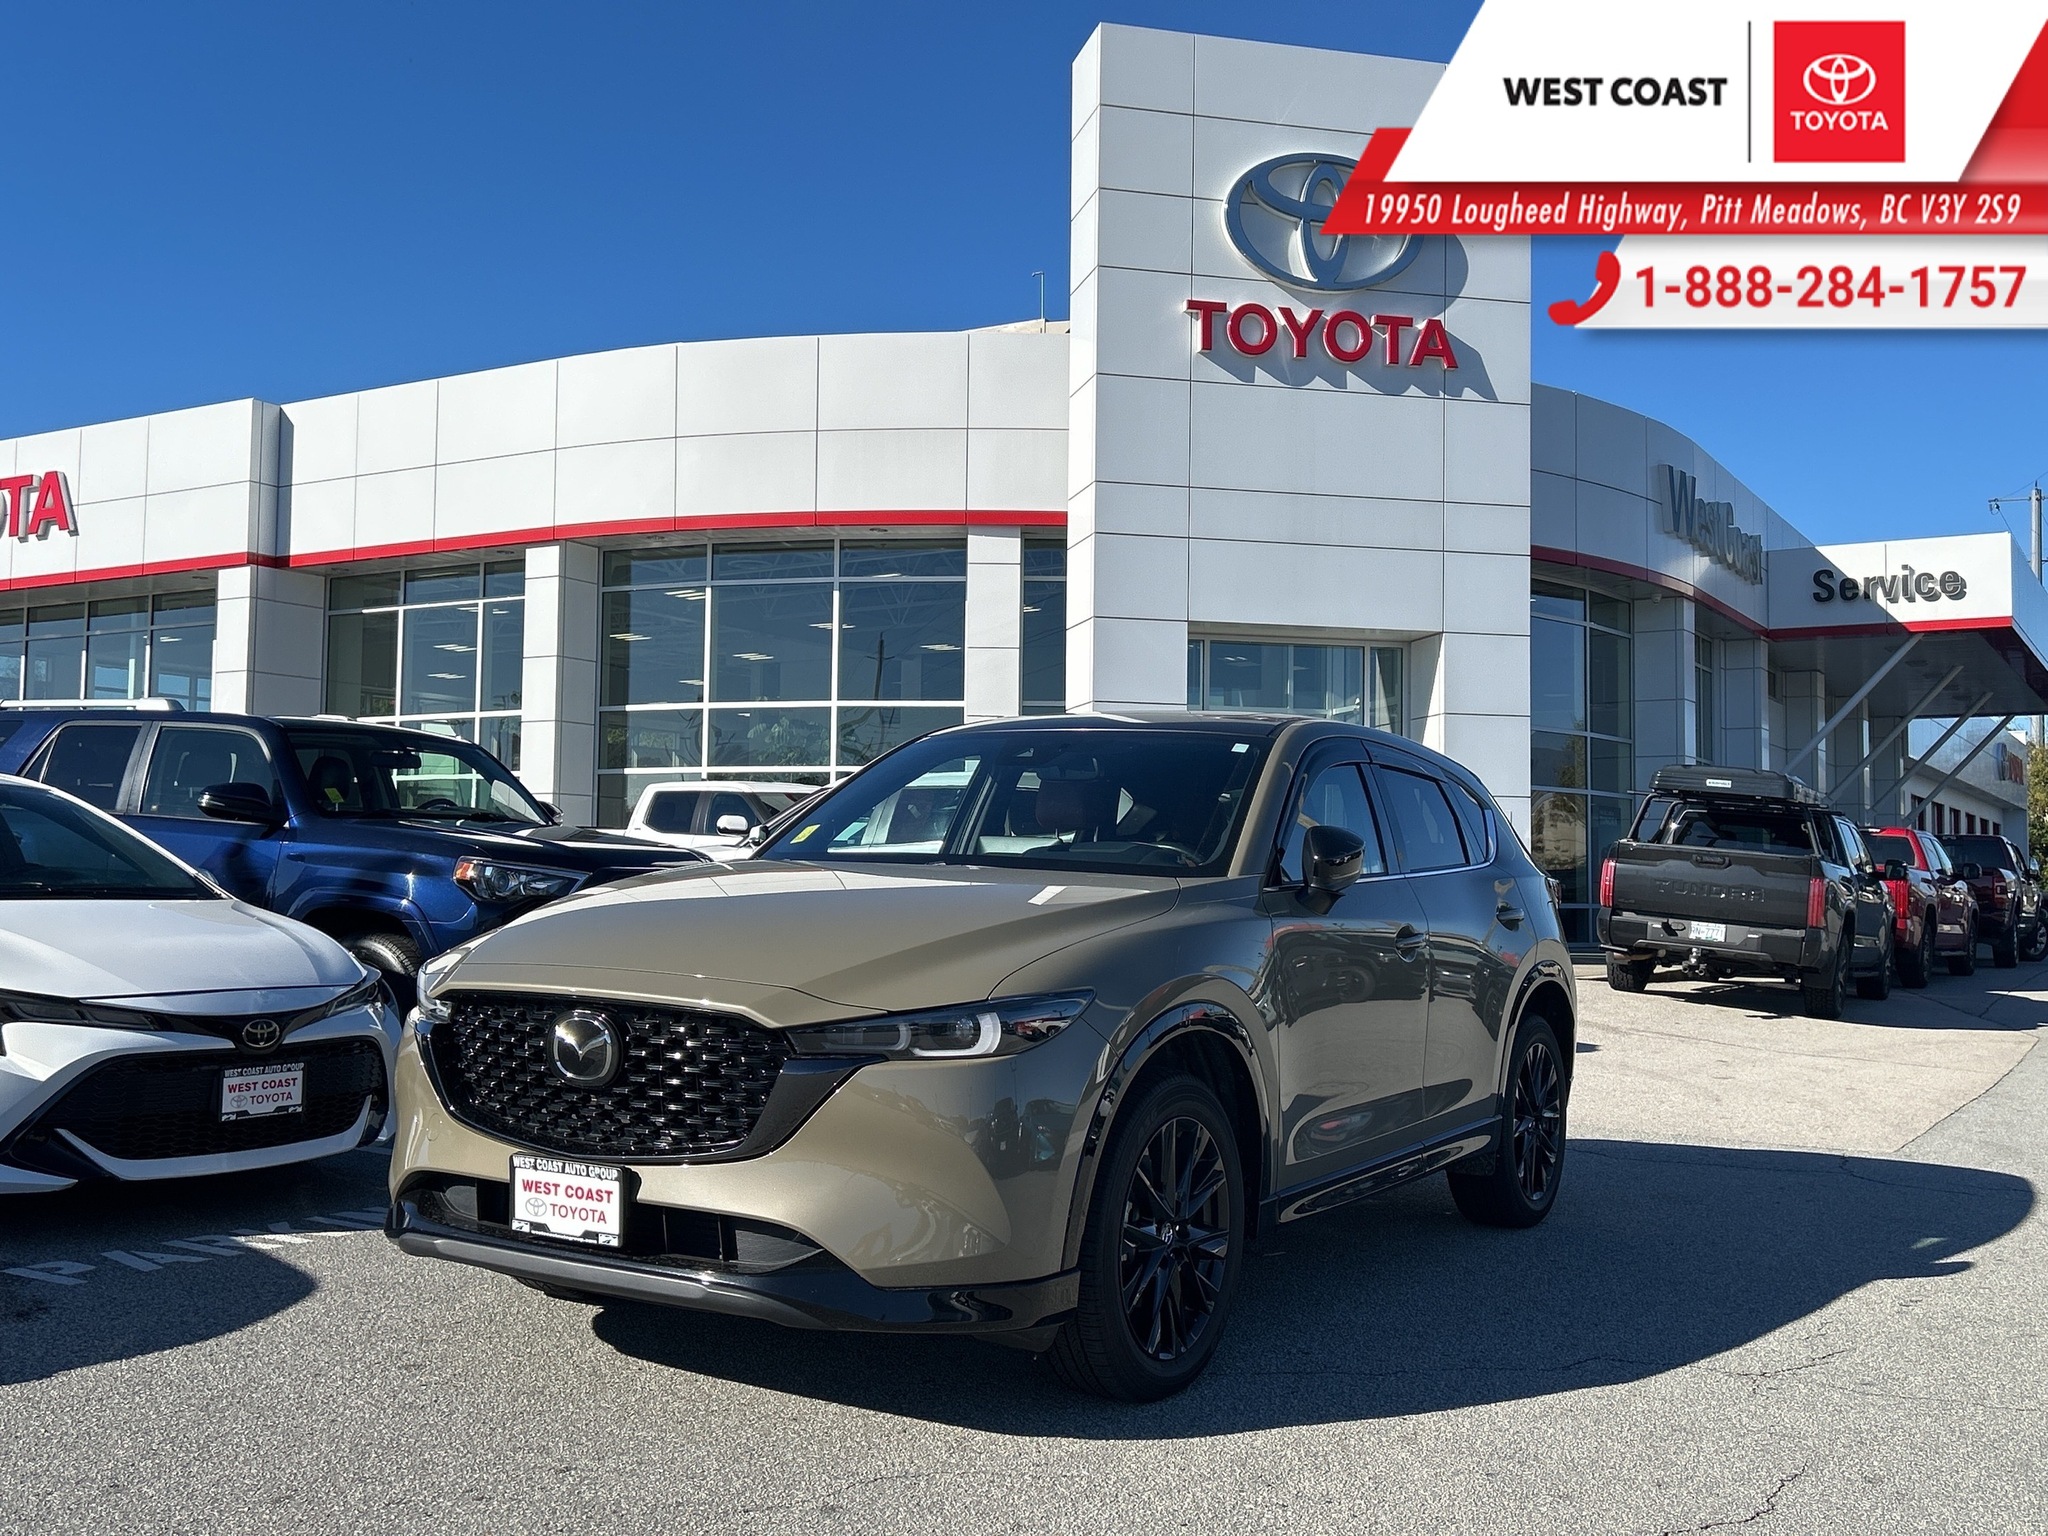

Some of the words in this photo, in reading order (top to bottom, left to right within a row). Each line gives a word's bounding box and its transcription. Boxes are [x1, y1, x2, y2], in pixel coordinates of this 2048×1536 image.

[1184, 298, 1460, 370] TOYOTA
[0, 470, 78, 542] TA
[1812, 564, 1967, 603] Service
[224, 1068, 241, 1078] WEST
[243, 1066, 263, 1076] COAST
[264, 1064, 281, 1073] AUTO
[228, 1081, 258, 1094] WEST
[261, 1077, 298, 1090] COAST
[250, 1092, 293, 1105] TOYOTA
[512, 1155, 534, 1169] WEST
[536, 1158, 564, 1173] COAST
[565, 1162, 586, 1176] AUTO
[522, 1179, 560, 1196] WEST
[564, 1185, 613, 1204] COAST
[550, 1203, 607, 1225] TOYOTA
